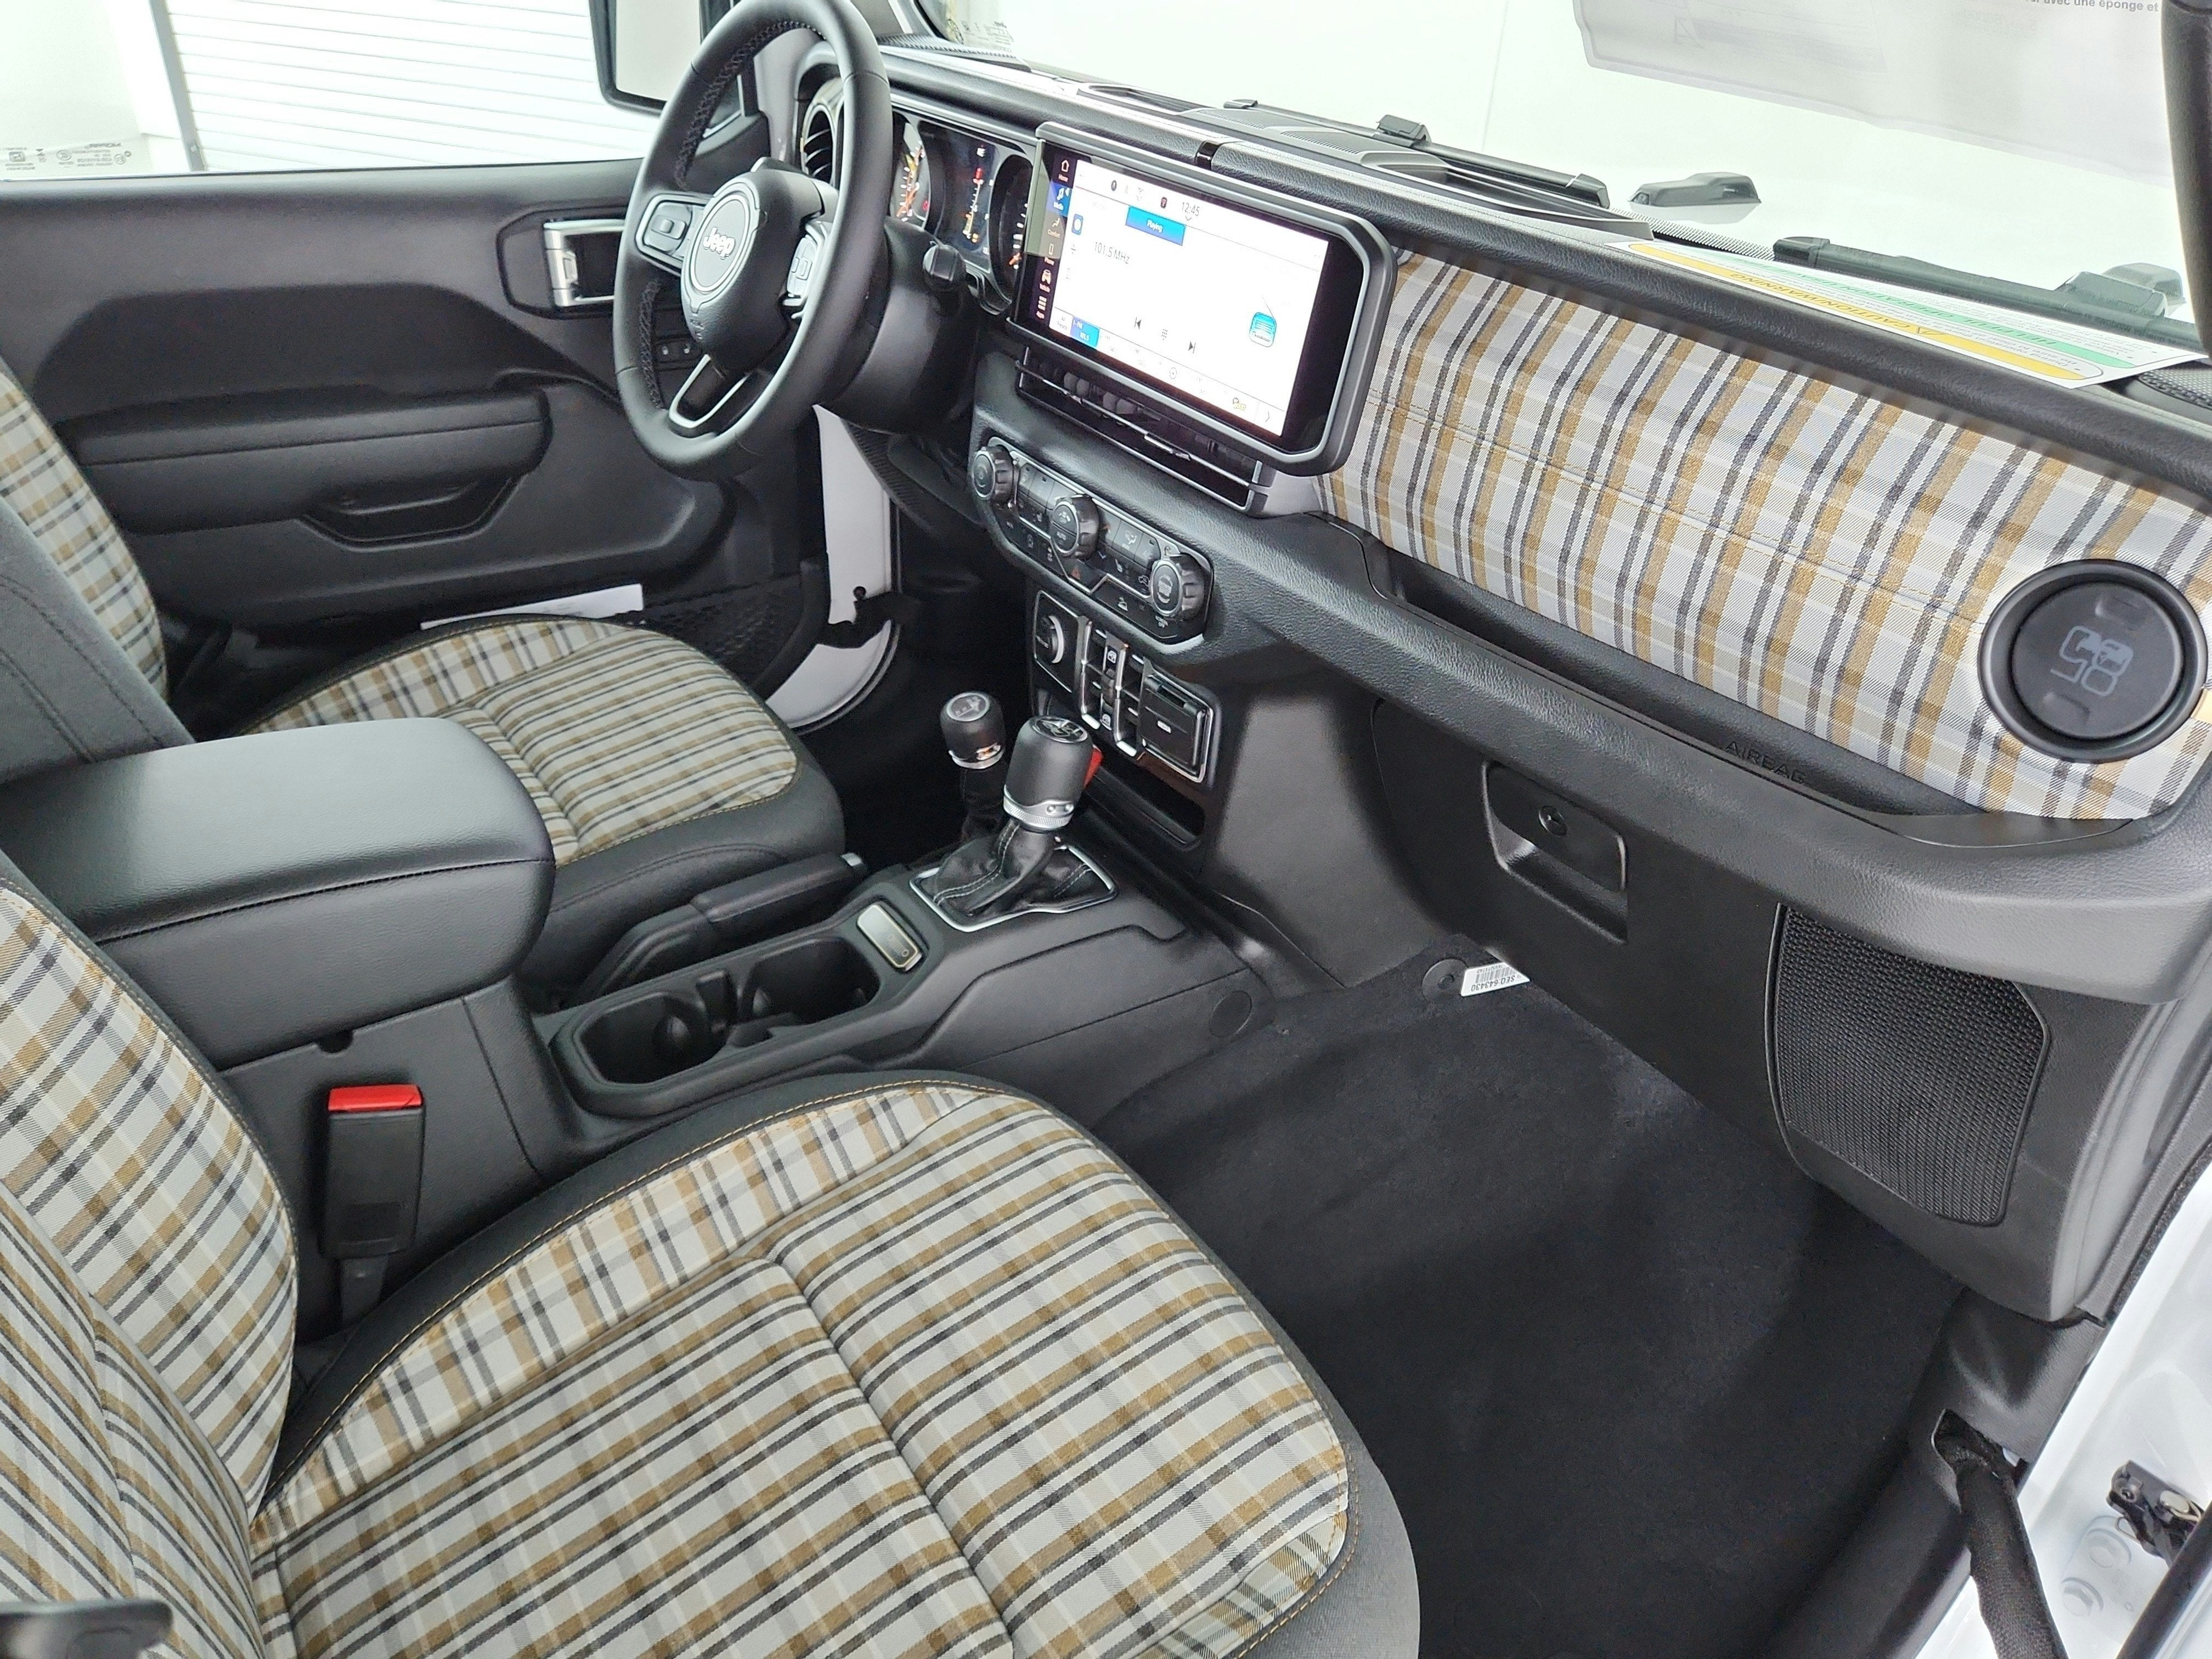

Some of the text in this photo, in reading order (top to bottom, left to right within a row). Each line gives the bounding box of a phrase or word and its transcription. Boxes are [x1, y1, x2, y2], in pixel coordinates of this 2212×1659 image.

[2099, 0, 2143, 12] éponge
[2147, 2, 2158, 12] et
[1182, 201, 1200, 216] 12:45
[1147, 218, 1164, 233] Playing
[703, 227, 735, 257] Jeep
[1094, 241, 1130, 264] 101.5 MHz
[1731, 274, 1911, 328] CAUTION/WARNING
[1726, 741, 1807, 785] AIRBAG
